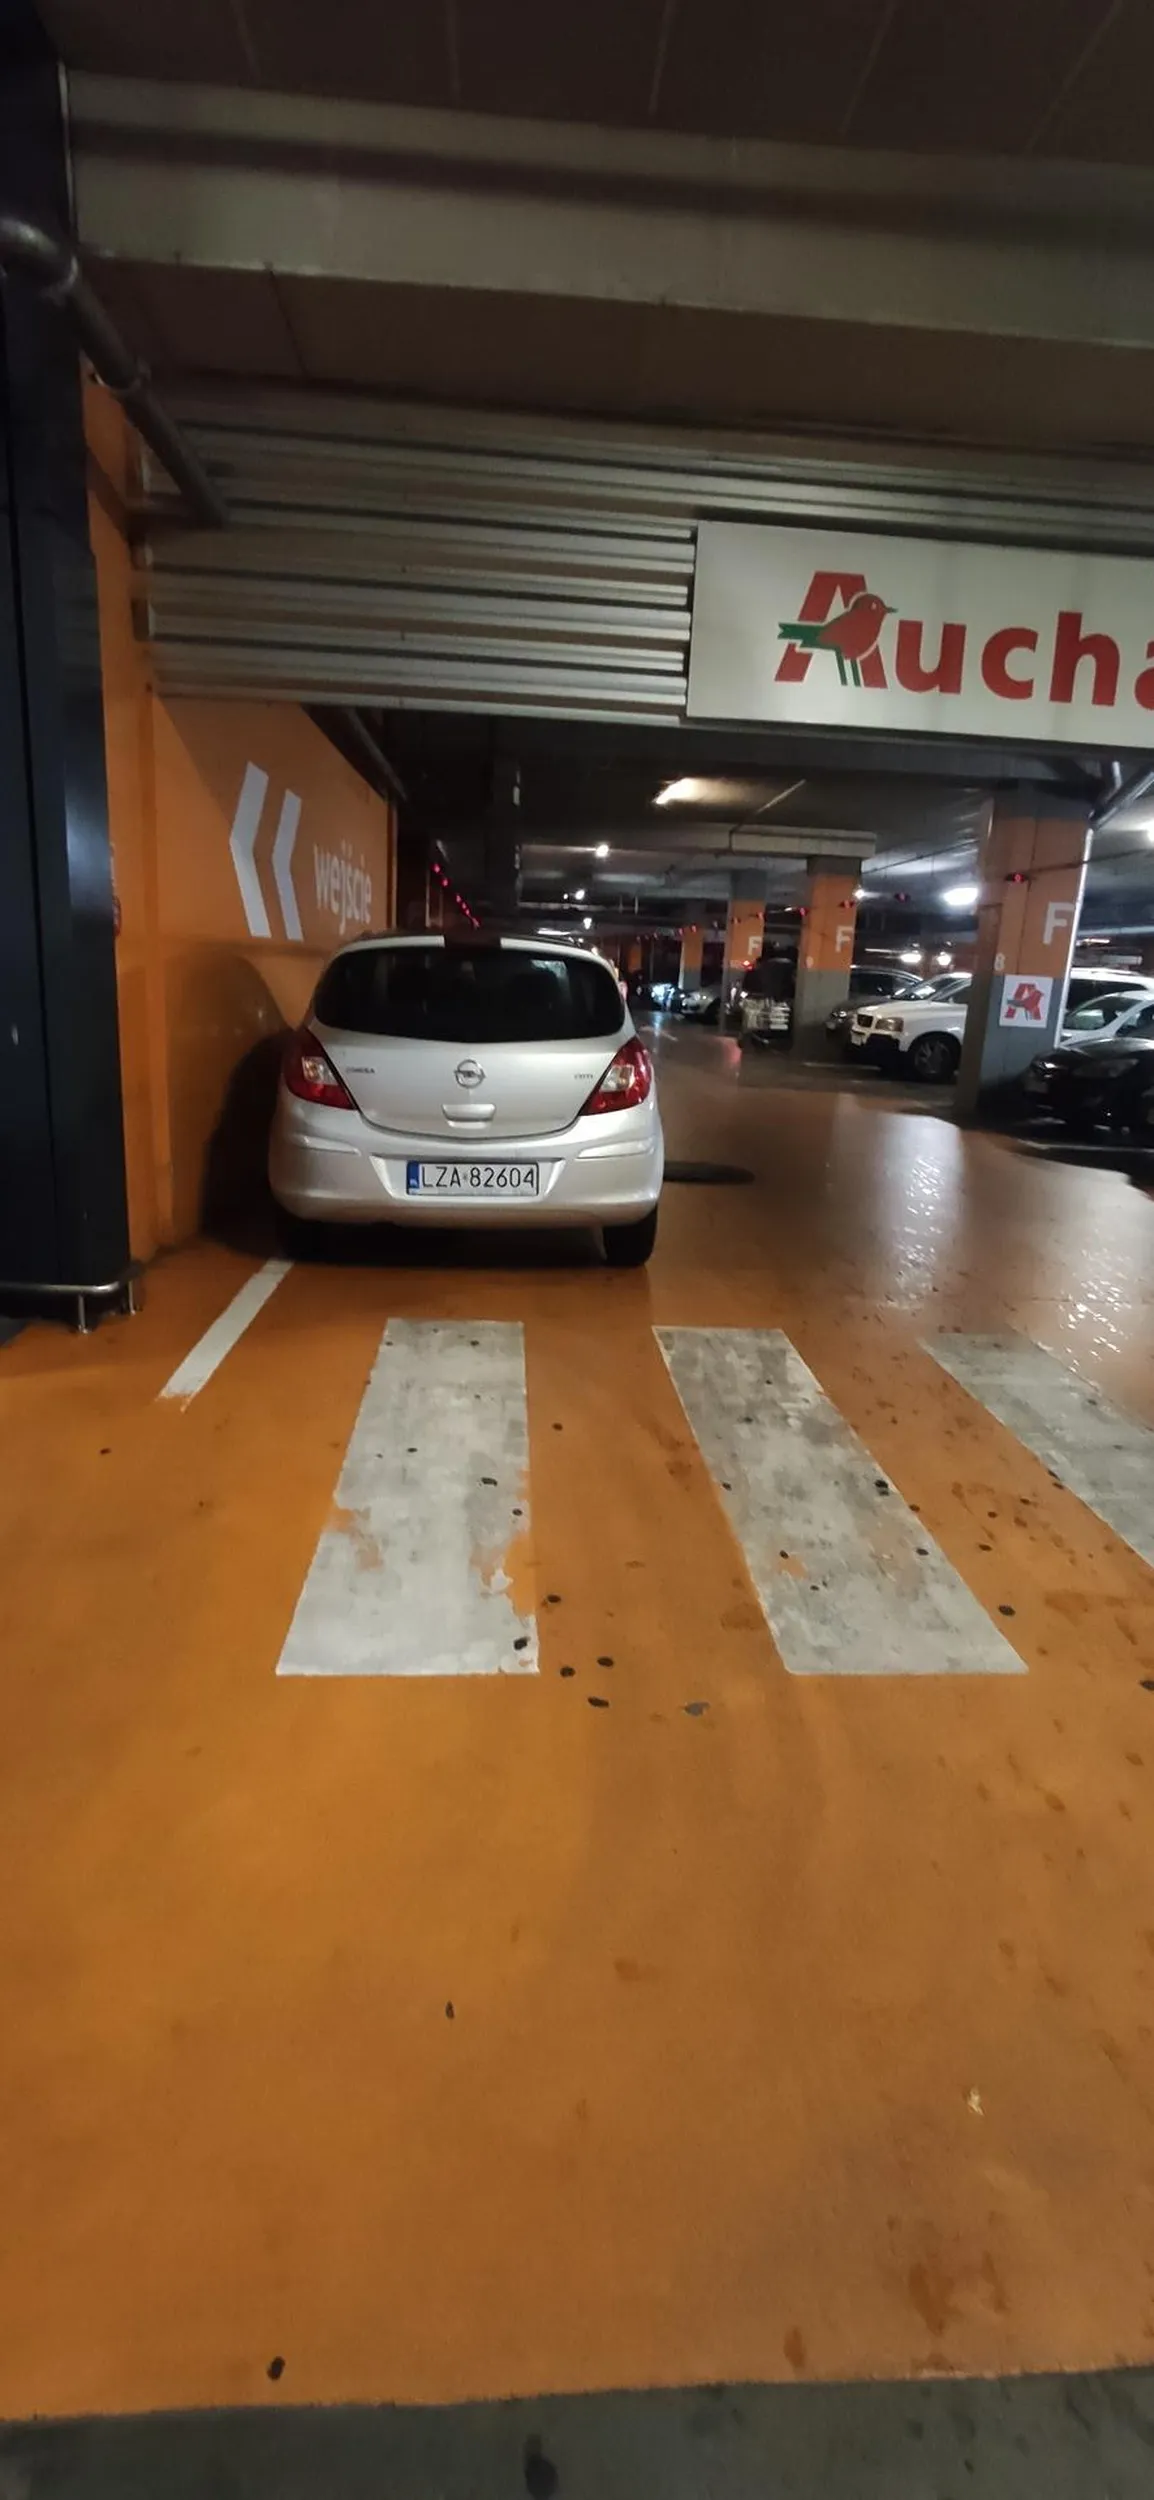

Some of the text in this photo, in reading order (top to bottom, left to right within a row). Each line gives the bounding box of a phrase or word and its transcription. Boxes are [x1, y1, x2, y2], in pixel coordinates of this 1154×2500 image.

[1043, 902, 1075, 944] F
[748, 936, 762, 955] F
[836, 926, 853, 952] F
[421, 1166, 534, 1188] LZA 82604
